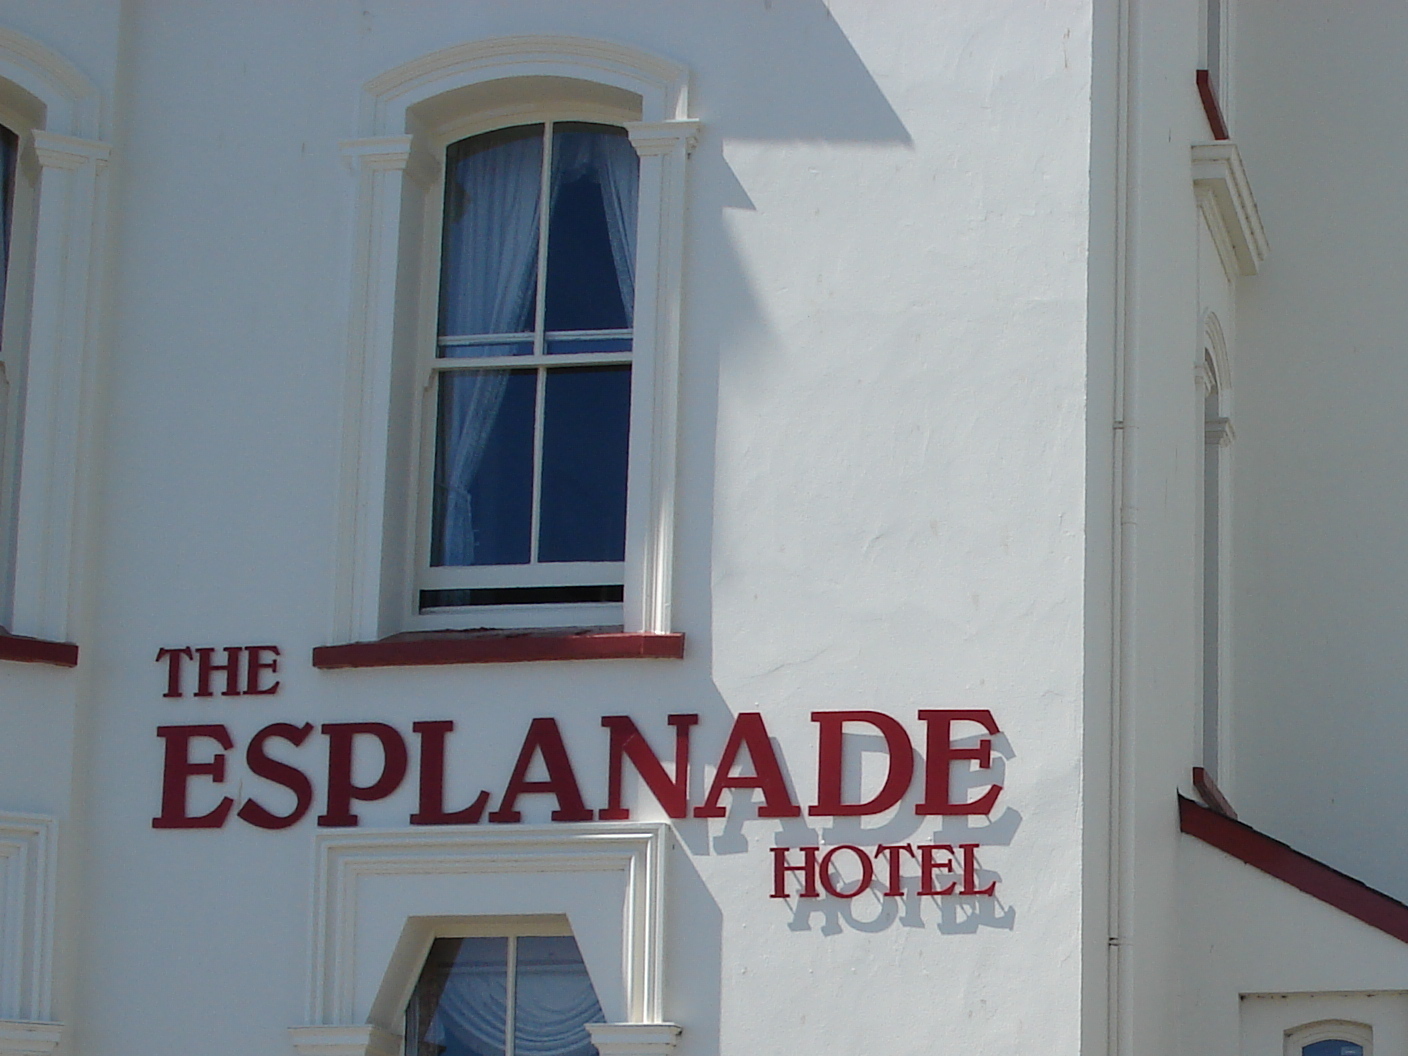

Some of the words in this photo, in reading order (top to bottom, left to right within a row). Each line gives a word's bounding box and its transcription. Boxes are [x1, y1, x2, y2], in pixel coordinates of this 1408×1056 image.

[155, 645, 281, 698] THE
[152, 708, 1004, 830] ESPLANADE
[769, 843, 997, 900] HOTEL
